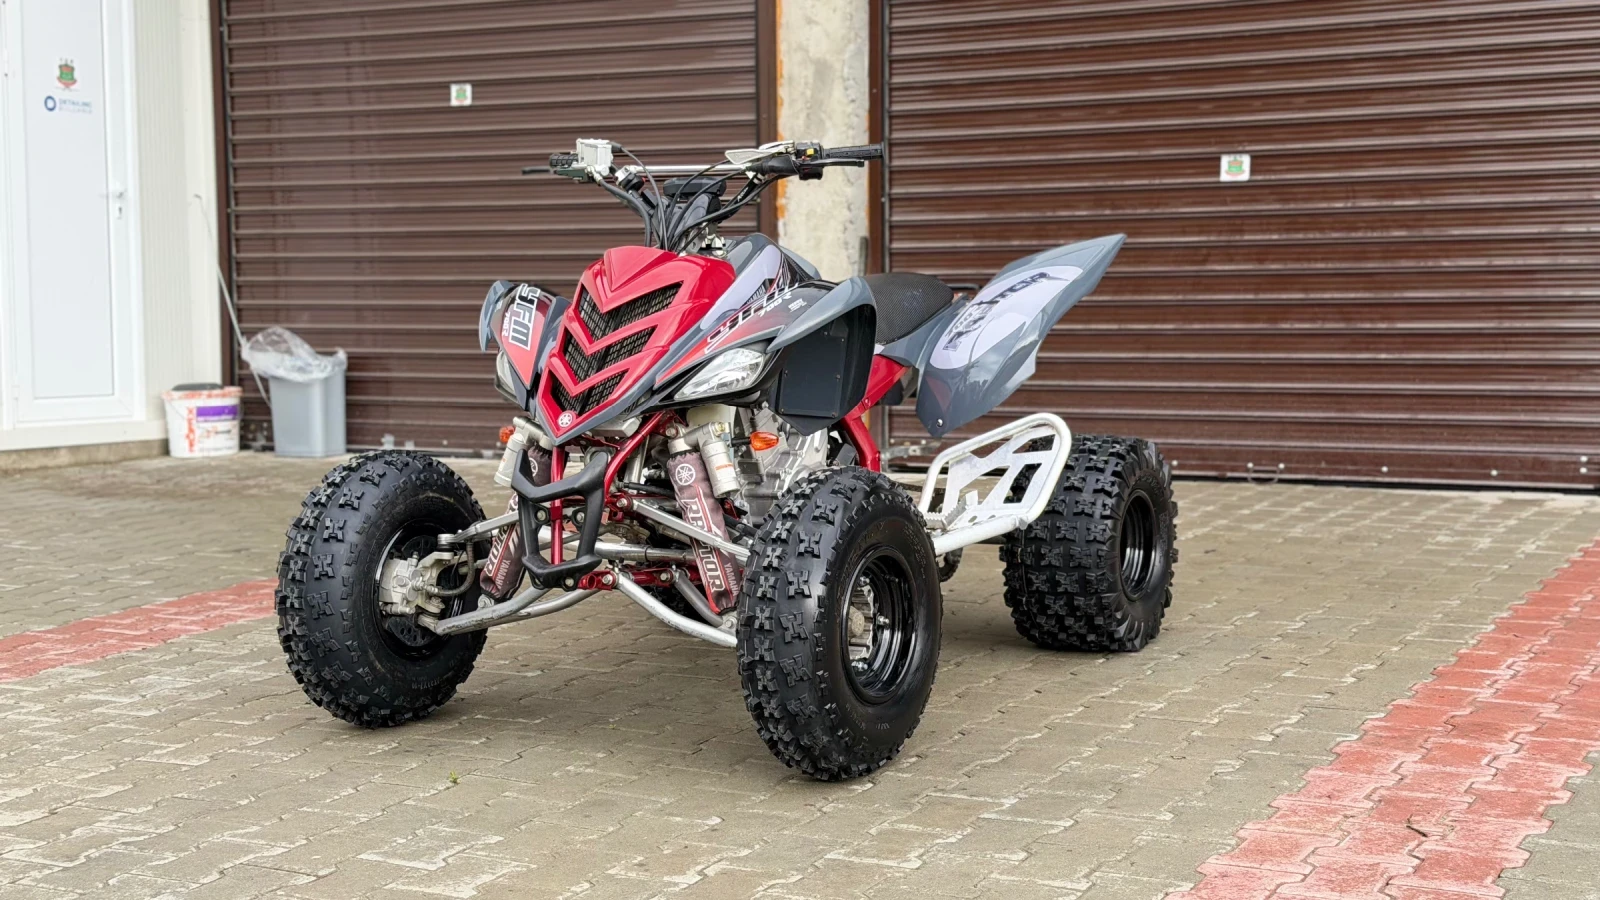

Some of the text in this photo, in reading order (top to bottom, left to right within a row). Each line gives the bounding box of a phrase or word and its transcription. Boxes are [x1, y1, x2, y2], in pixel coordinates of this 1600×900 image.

[509, 283, 541, 351] YFM
[757, 291, 793, 317] 700R
[501, 311, 511, 337] 700R
[681, 497, 726, 594] RATOR
[724, 562, 740, 597] YAMAHA
